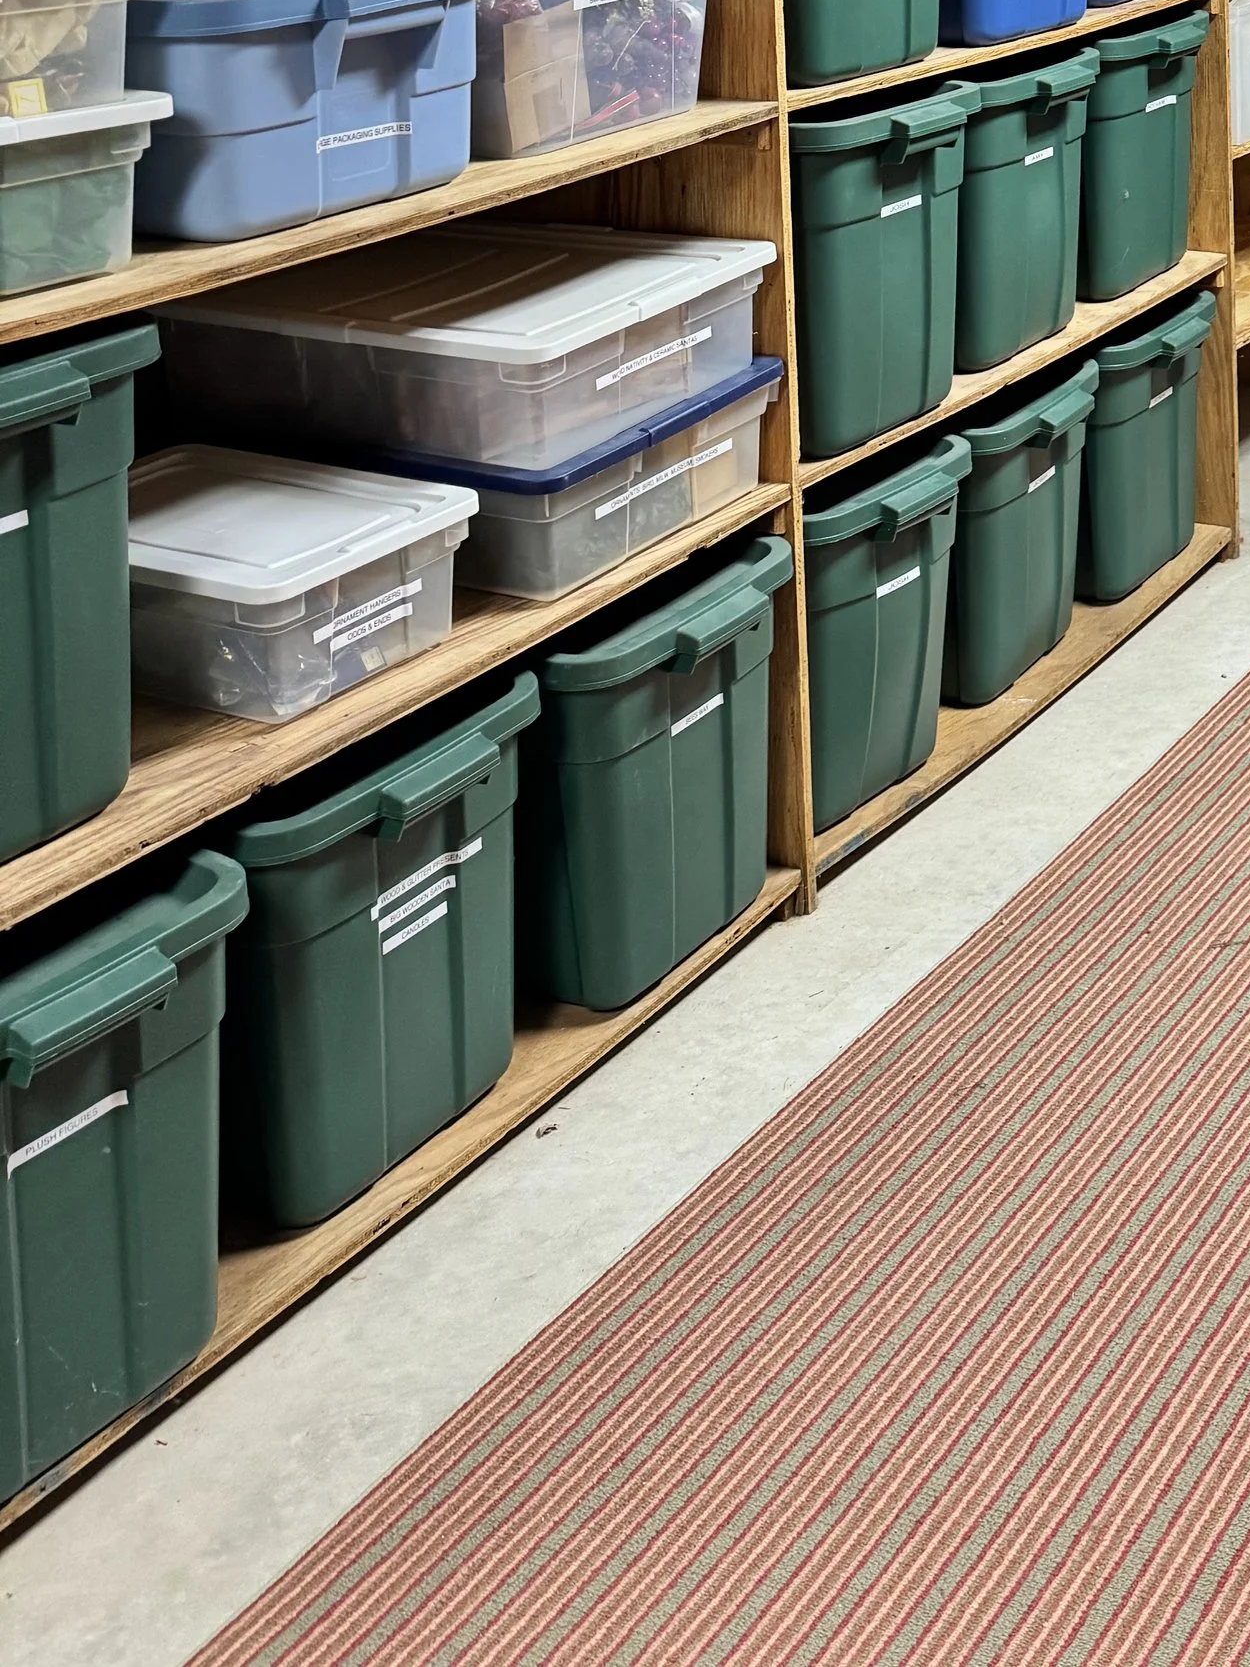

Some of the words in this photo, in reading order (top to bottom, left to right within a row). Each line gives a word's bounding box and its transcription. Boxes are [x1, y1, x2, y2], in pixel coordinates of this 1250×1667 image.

[333, 130, 374, 143] PACKAGING
[374, 123, 411, 136] SUPPLIES
[889, 201, 910, 213] JOSH
[626, 357, 648, 371] NATIVITY
[653, 345, 676, 359] CERAMIC
[676, 336, 698, 348] SANTAS
[888, 576, 909, 590] JOSH
[333, 606, 368, 629] ORNAMENT
[369, 589, 401, 608] HANGERS
[347, 627, 367, 641] ODDS
[374, 614, 391, 627] ENDS
[381, 888, 400, 904] WOOD
[407, 867, 432, 887] GLITTER
[432, 851, 469, 871] PRESENTS
[390, 910, 401, 923] BIG
[402, 893, 428, 915] WOODEN
[430, 879, 451, 896] SANTA
[401, 916, 430, 940] CANDLES
[25, 1133, 57, 1157] PLUSH
[59, 1108, 99, 1135] FIGURES
